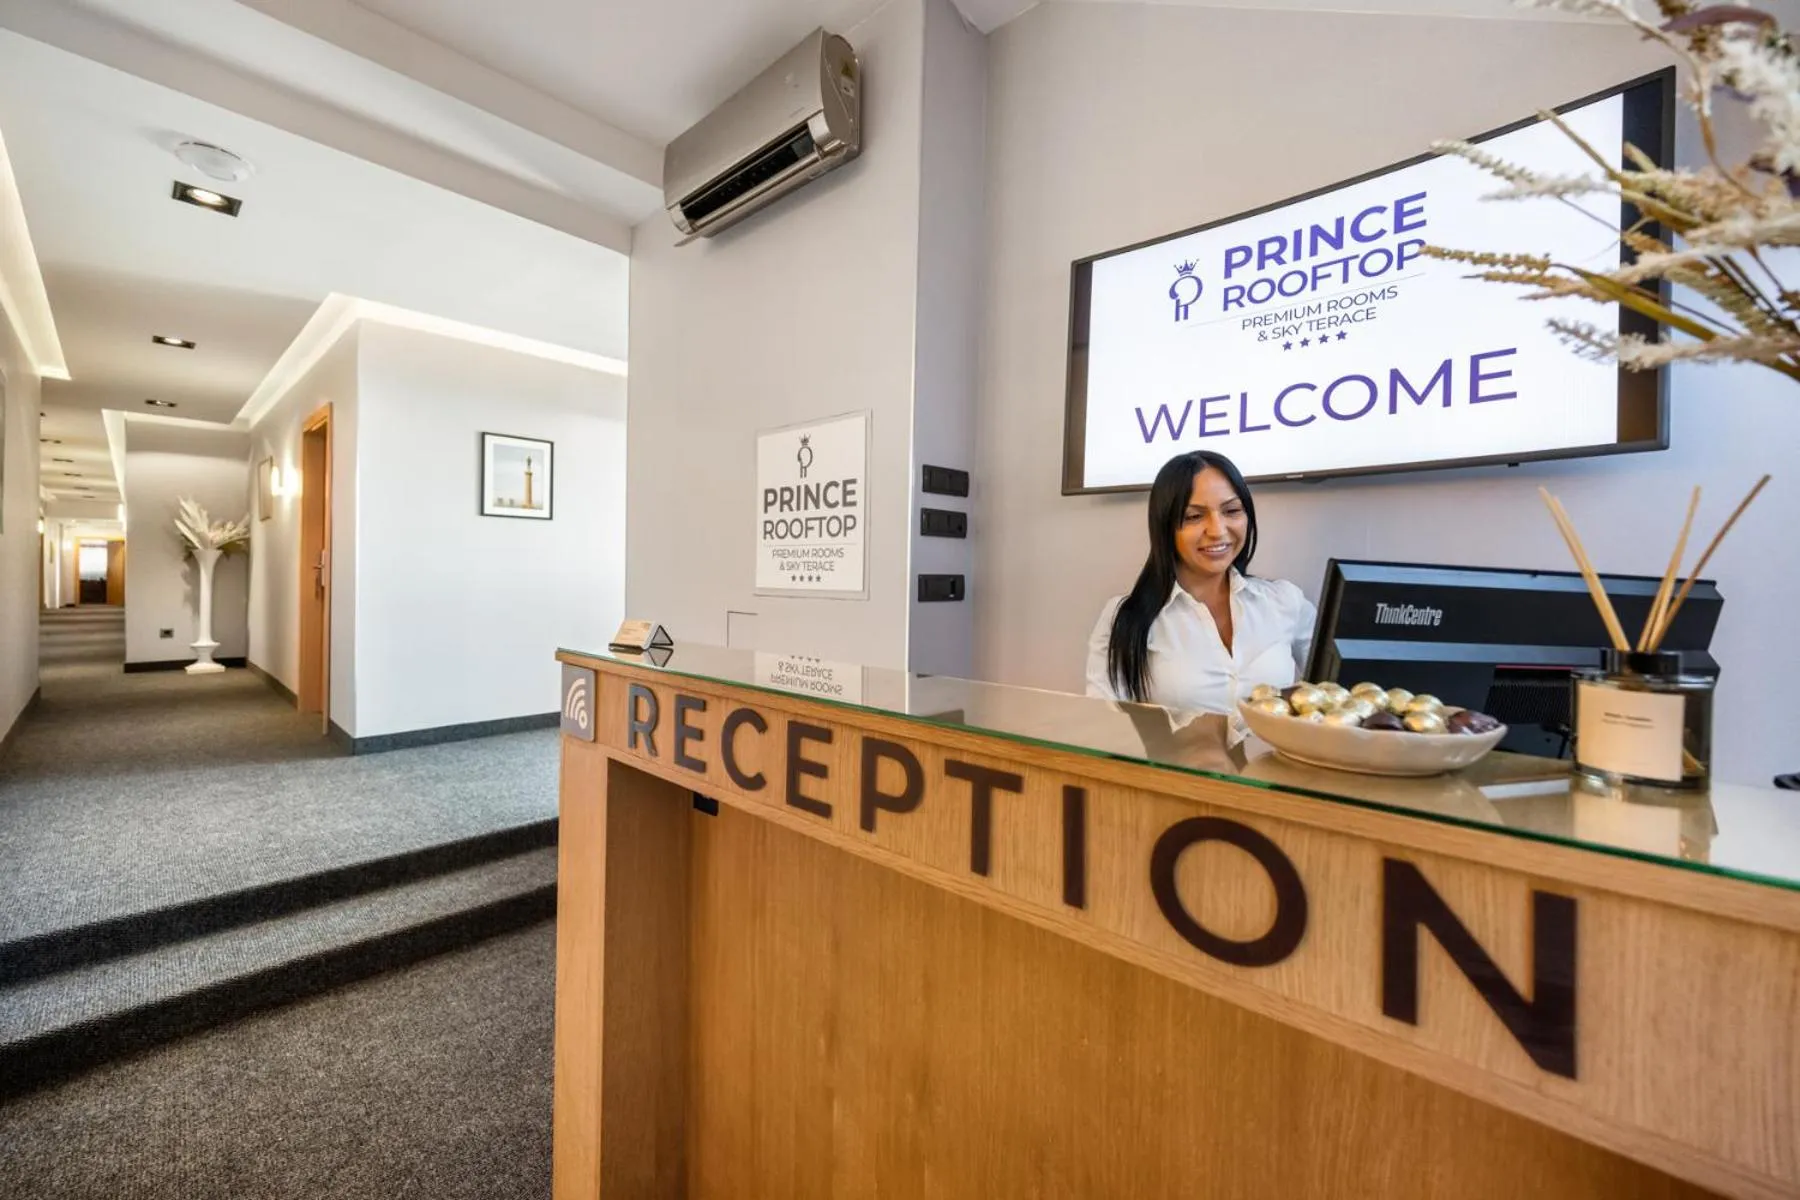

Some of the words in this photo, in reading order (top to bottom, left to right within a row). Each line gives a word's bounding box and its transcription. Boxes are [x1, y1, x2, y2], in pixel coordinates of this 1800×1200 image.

[1224, 191, 1427, 279] PRINCE
[1222, 238, 1427, 312] ROOFTOP
[1241, 302, 1322, 331] PREMIUM
[1326, 285, 1399, 313] ROOMS
[1257, 330, 1269, 342] &
[1271, 322, 1303, 340] SKY
[1307, 306, 1377, 332] TERACE
[1135, 347, 1518, 444] WELCOME
[763, 478, 858, 514] PRINCE
[763, 514, 857, 540] ROOFTOP
[772, 548, 810, 559] PREMIUM
[811, 547, 845, 558] ROOMS
[786, 561, 801, 571] SKY
[801, 560, 835, 572] TERACE
[1375, 602, 1443, 626] ThinkCentre
[627, 682, 1578, 1081] RECEPTION
